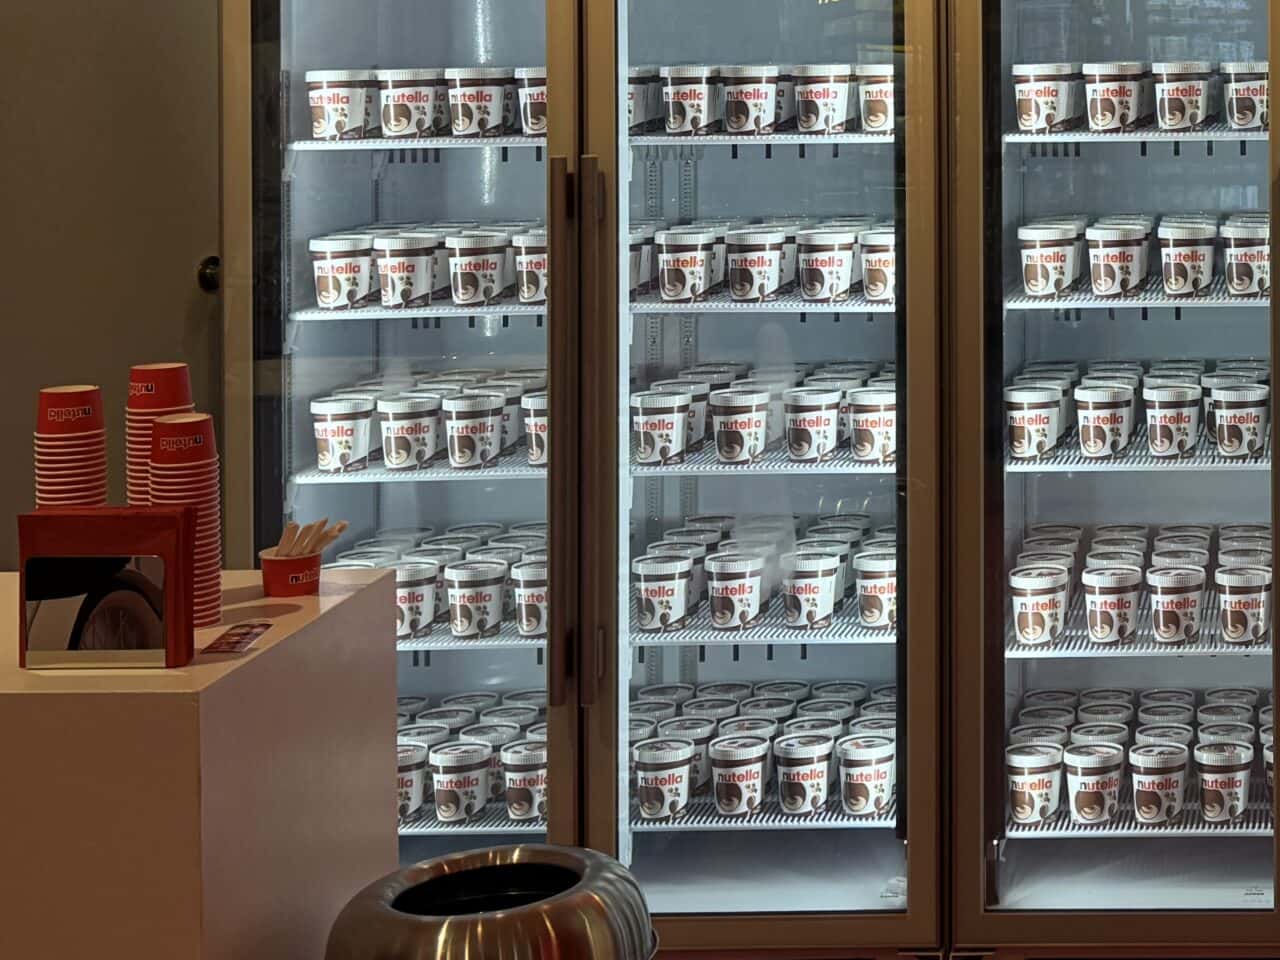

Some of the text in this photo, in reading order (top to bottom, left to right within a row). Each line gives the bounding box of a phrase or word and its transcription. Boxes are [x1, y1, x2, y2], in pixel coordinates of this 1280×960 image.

[726, 89, 768, 101] nutella
[797, 88, 837, 100] nutella
[1162, 86, 1201, 97] nutella
[731, 257, 772, 268] nutella
[802, 256, 843, 268] nutella
[1166, 252, 1205, 263] nutella
[454, 260, 497, 271] nutella
[789, 416, 830, 428] nutella
[853, 418, 893, 428] nutella
[1220, 413, 1260, 424] nutella
[450, 423, 494, 434] nutella
[720, 419, 761, 431] nutella
[712, 584, 753, 596] nutella
[641, 774, 682, 786] nutella
[719, 770, 759, 782] nutella
[783, 769, 824, 782] nutella
[845, 769, 887, 782] nutella
[437, 777, 478, 788] nutella
[1080, 778, 1119, 790] nutella
[1138, 779, 1179, 790] nutella
[1202, 778, 1241, 790] nutella
